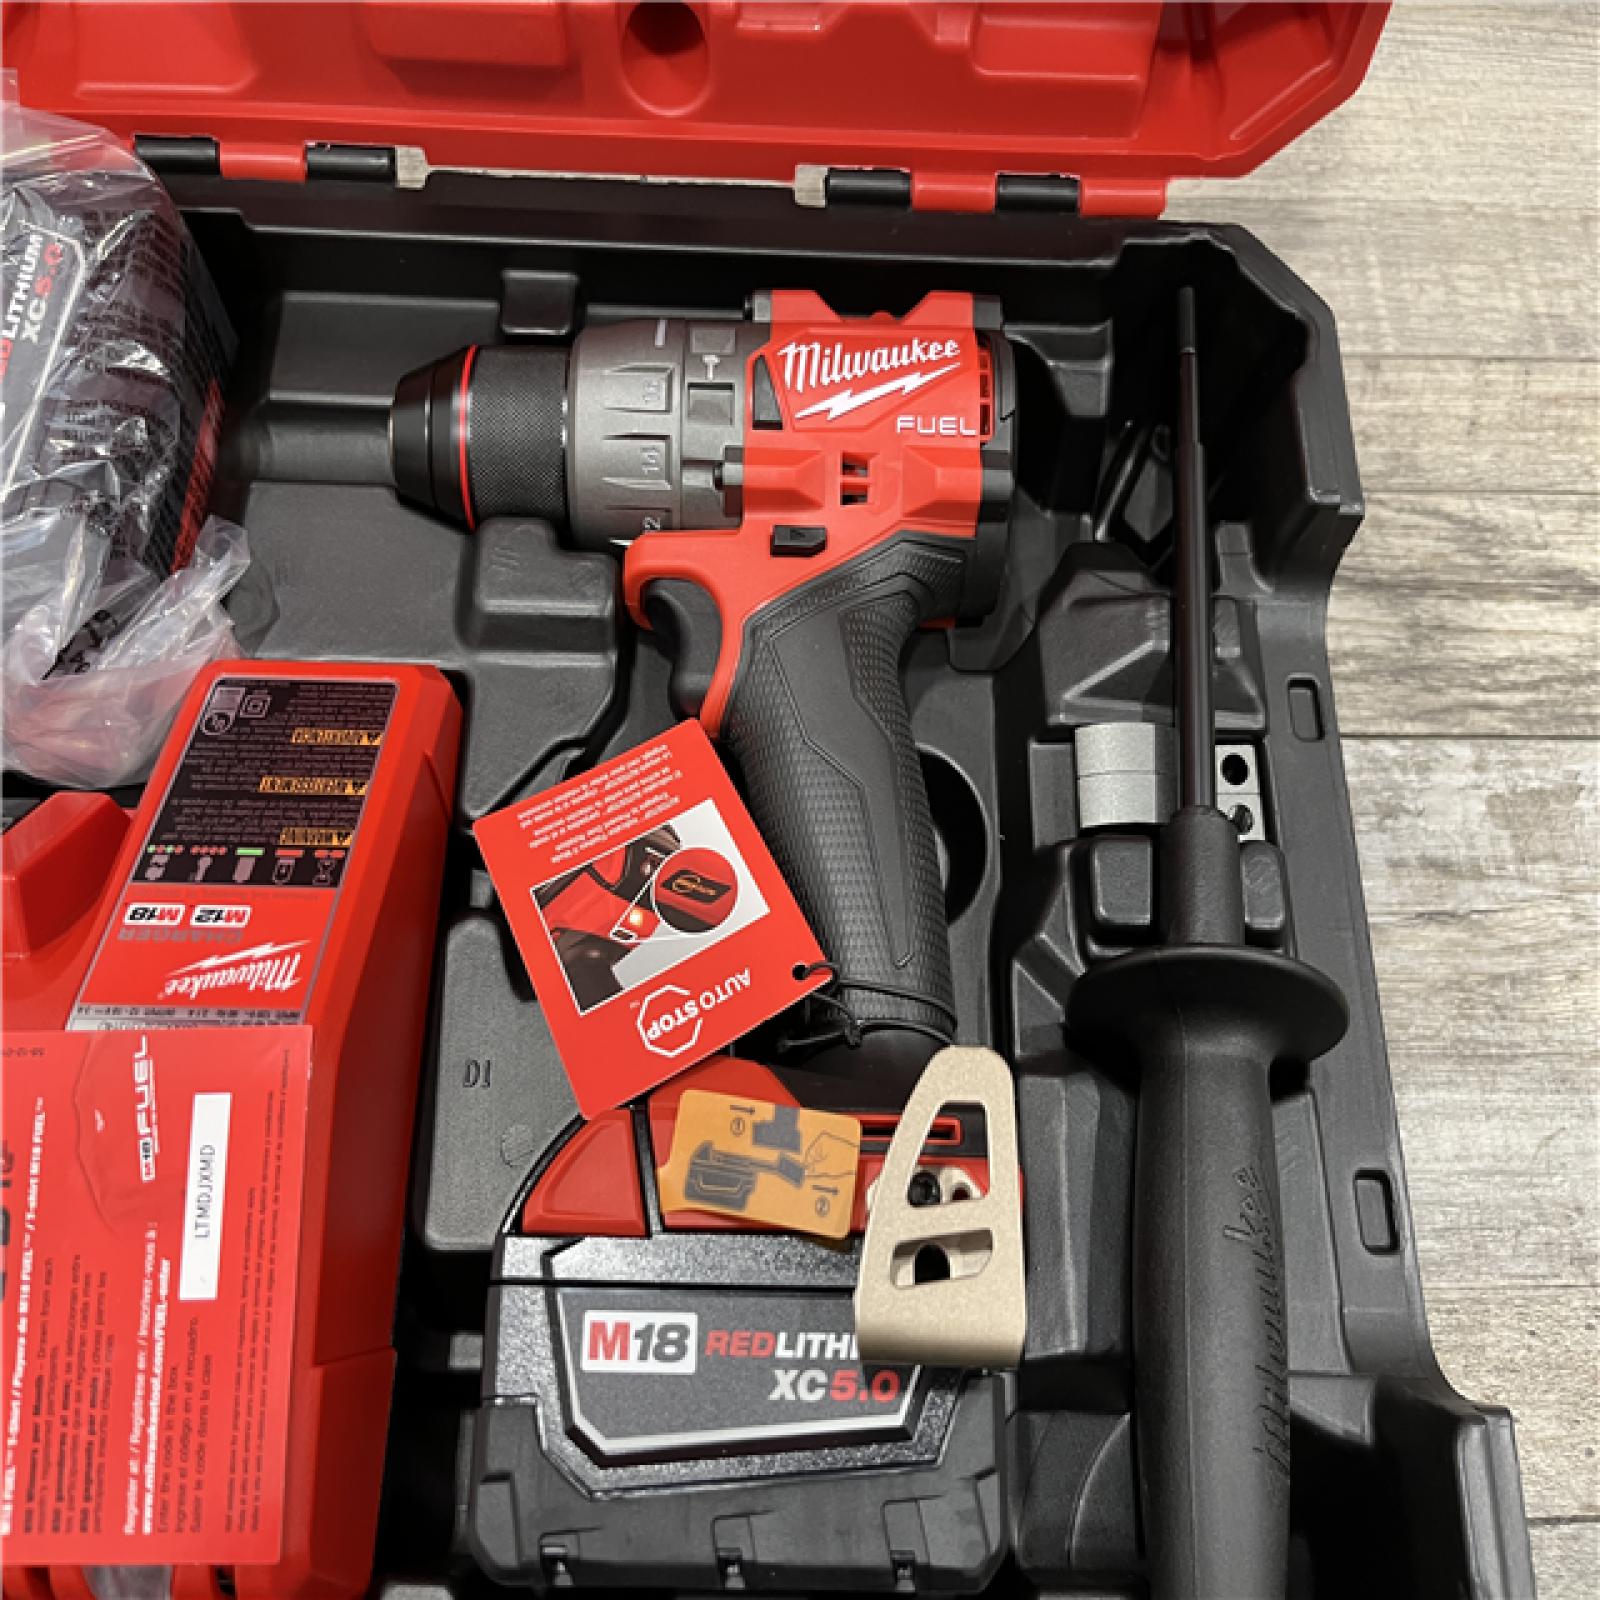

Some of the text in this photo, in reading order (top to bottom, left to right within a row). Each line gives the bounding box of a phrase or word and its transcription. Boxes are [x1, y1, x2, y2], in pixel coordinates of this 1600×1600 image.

[777, 337, 961, 393] Milwaukee
[896, 416, 976, 436] FUEL
[118, 927, 242, 944] CHARGER
[128, 905, 248, 925] M12 M18
[164, 952, 302, 998] Milwaukee
[647, 966, 751, 1041] AUTO STOP
[134, 1035, 151, 1136] FUEL
[194, 1145, 215, 1239] LTMDJXMD
[588, 1320, 859, 1362] M18 REDLITHI
[768, 1368, 899, 1403] XC5.0
[124, 1479, 139, 1535] Register
